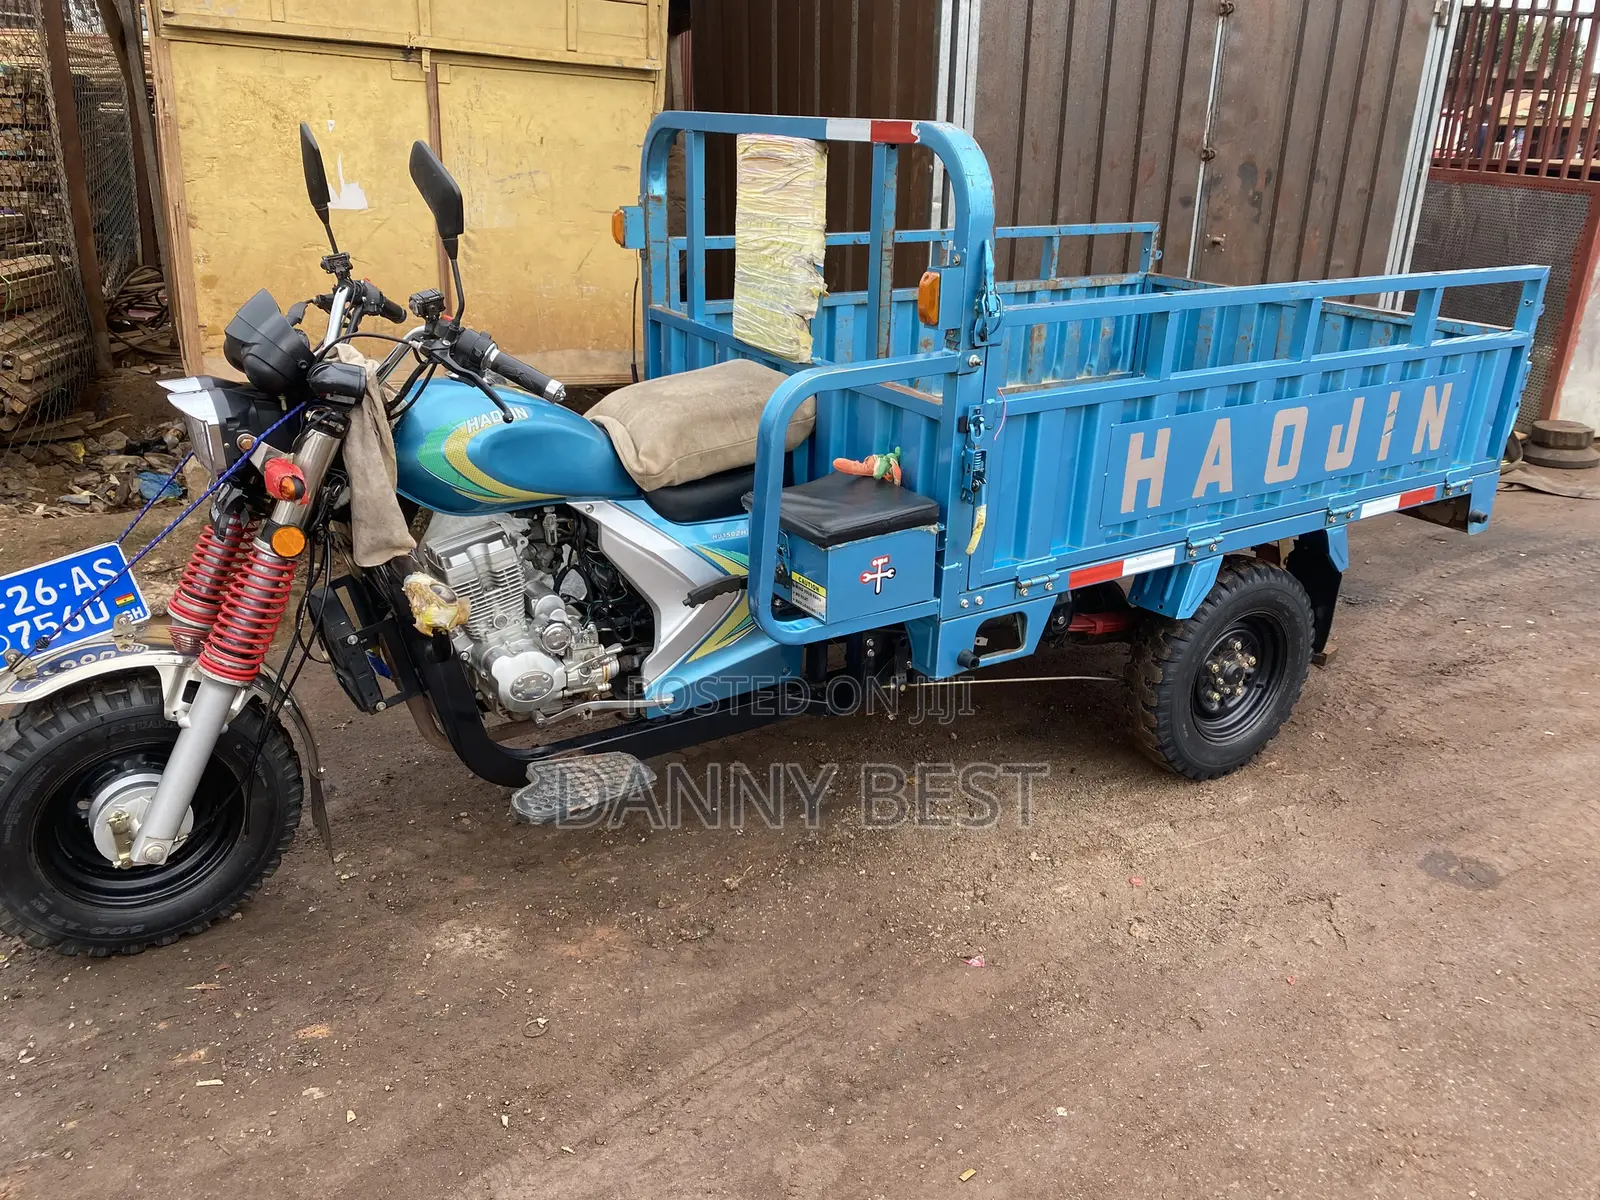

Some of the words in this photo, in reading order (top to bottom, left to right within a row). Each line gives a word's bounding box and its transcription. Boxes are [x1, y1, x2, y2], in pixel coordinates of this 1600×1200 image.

[465, 407, 529, 433] HAOIN
[1120, 382, 1454, 514] HAOJIN
[798, 576, 820, 593] CAUTION
